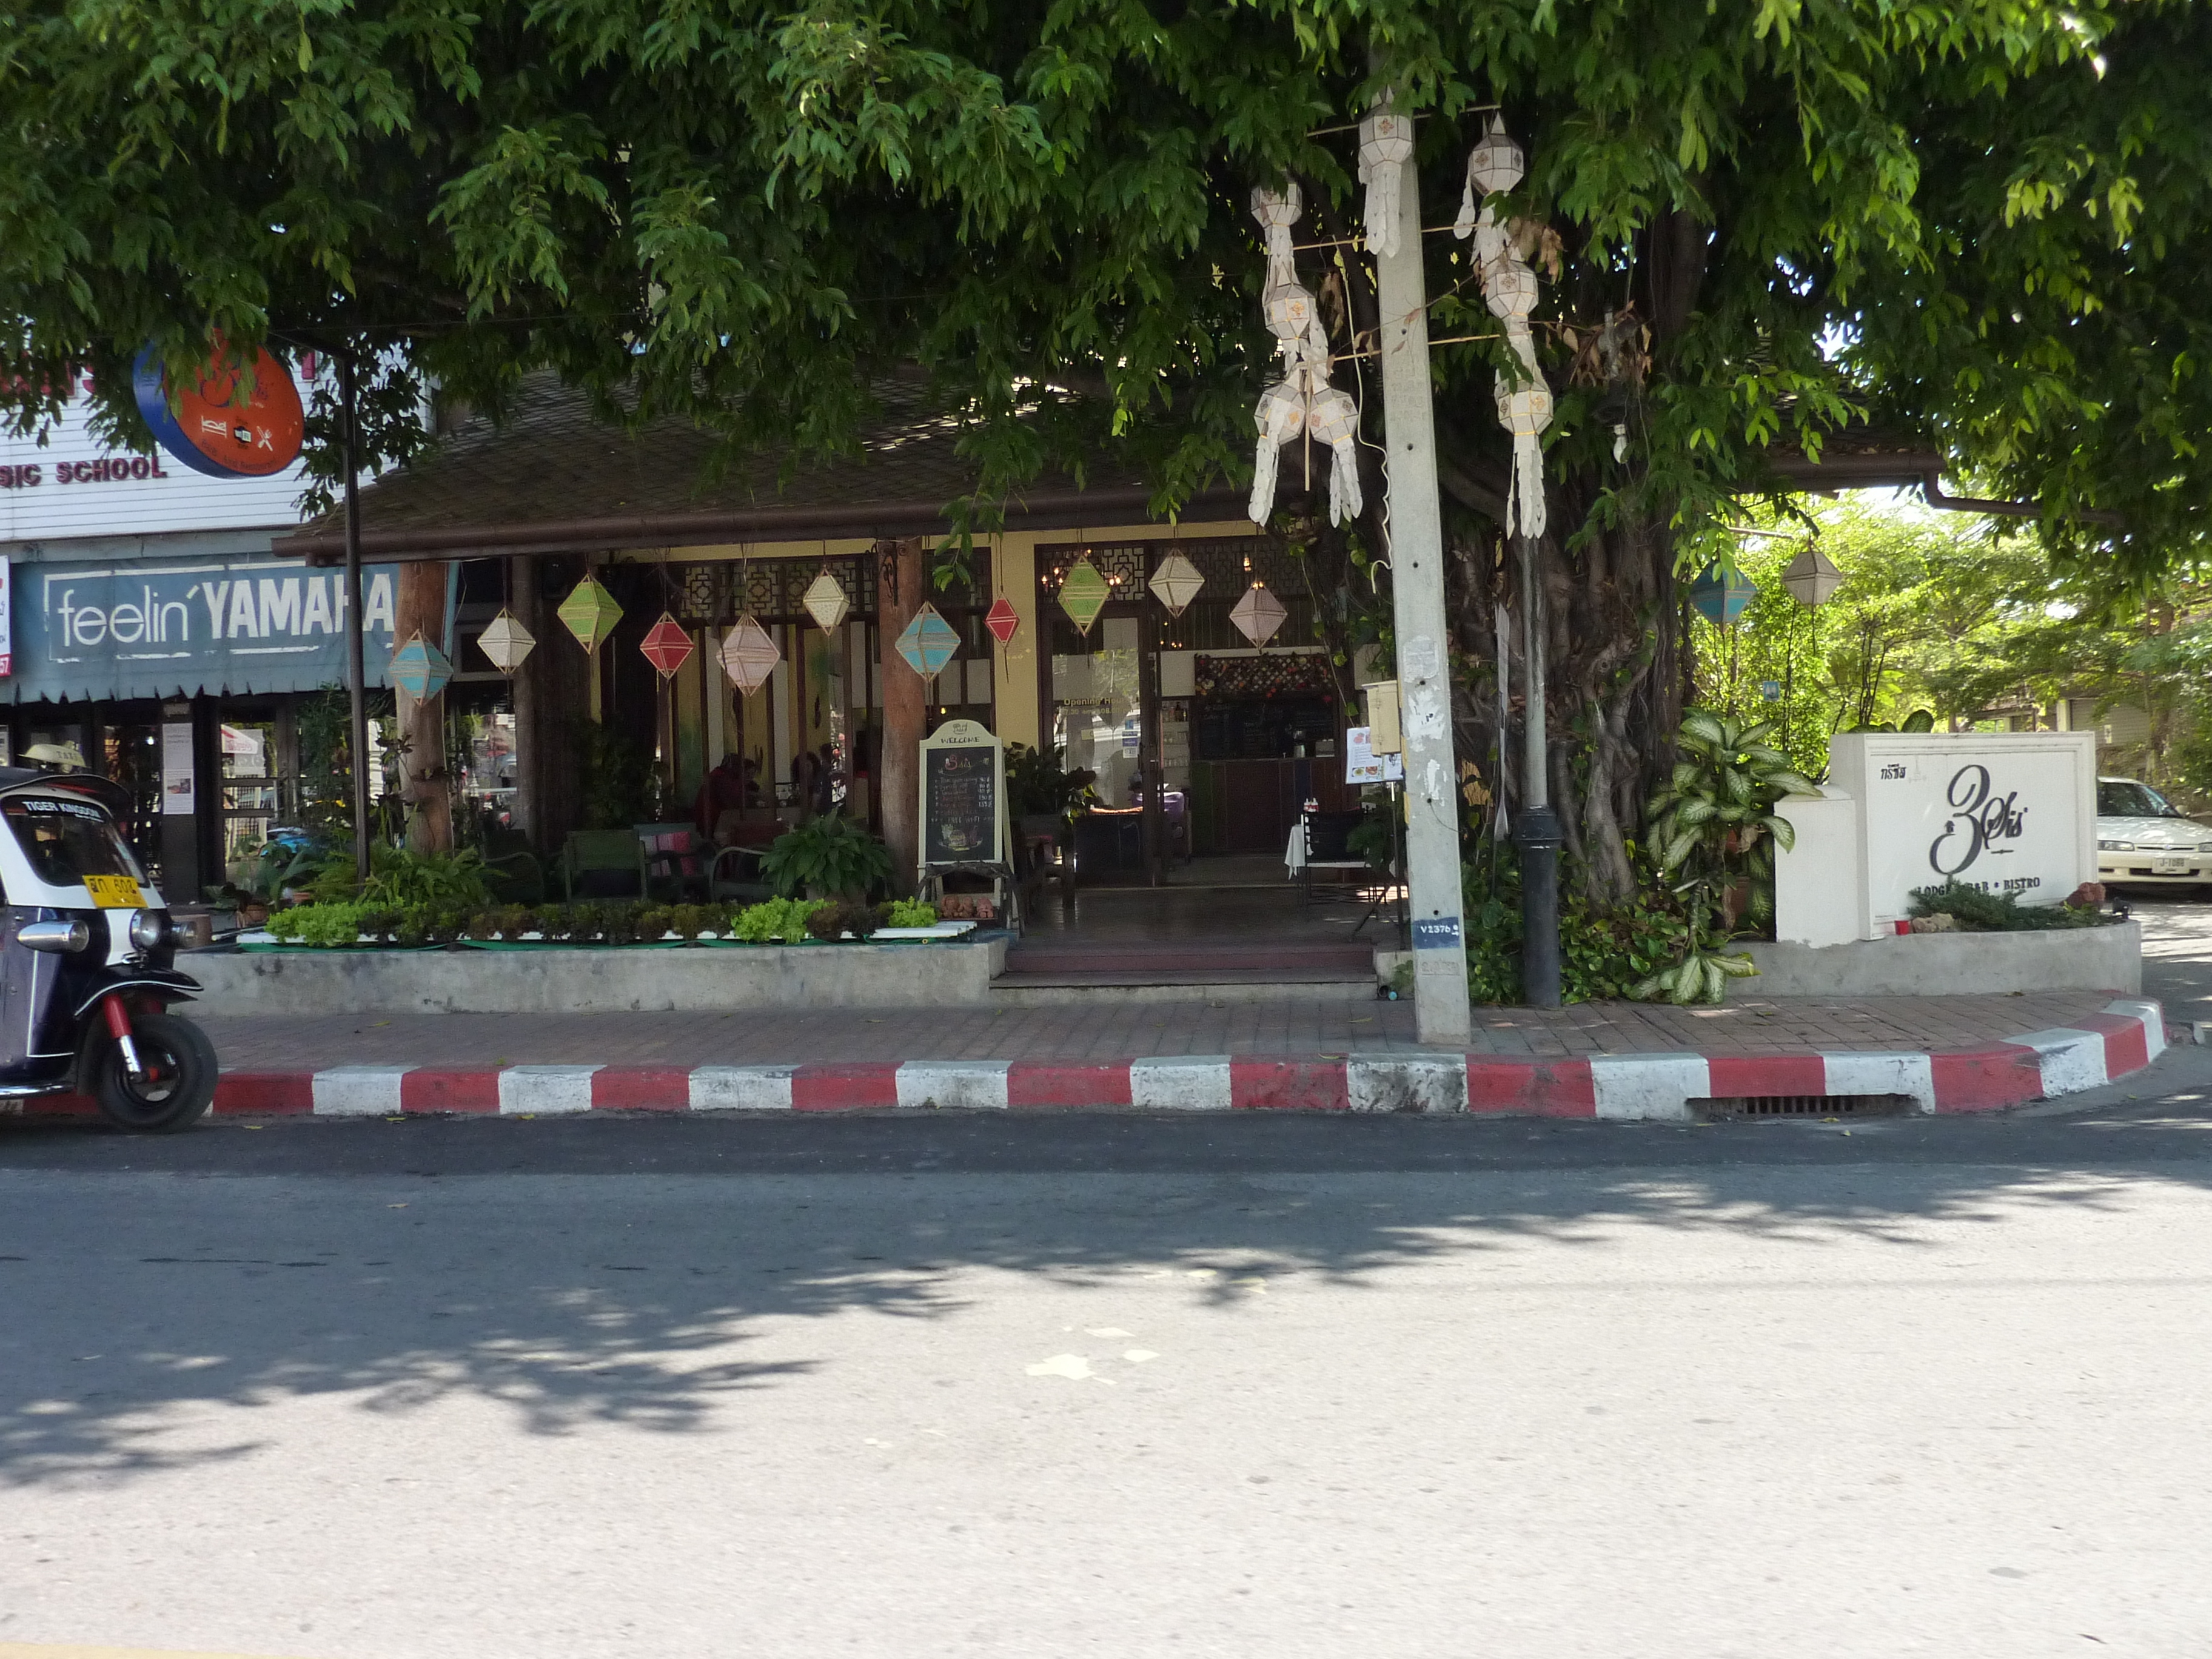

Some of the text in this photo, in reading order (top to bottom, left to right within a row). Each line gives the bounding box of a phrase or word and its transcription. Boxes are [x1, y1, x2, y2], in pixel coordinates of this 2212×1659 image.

[56, 455, 168, 484] SCHOOL
[1064, 698, 1101, 707] Opening
[22, 801, 59, 811] TIGER
[58, 803, 101, 819] KINGDOM
[1929, 765, 1990, 875] 3
[2003, 877, 2040, 890] BISTRO
